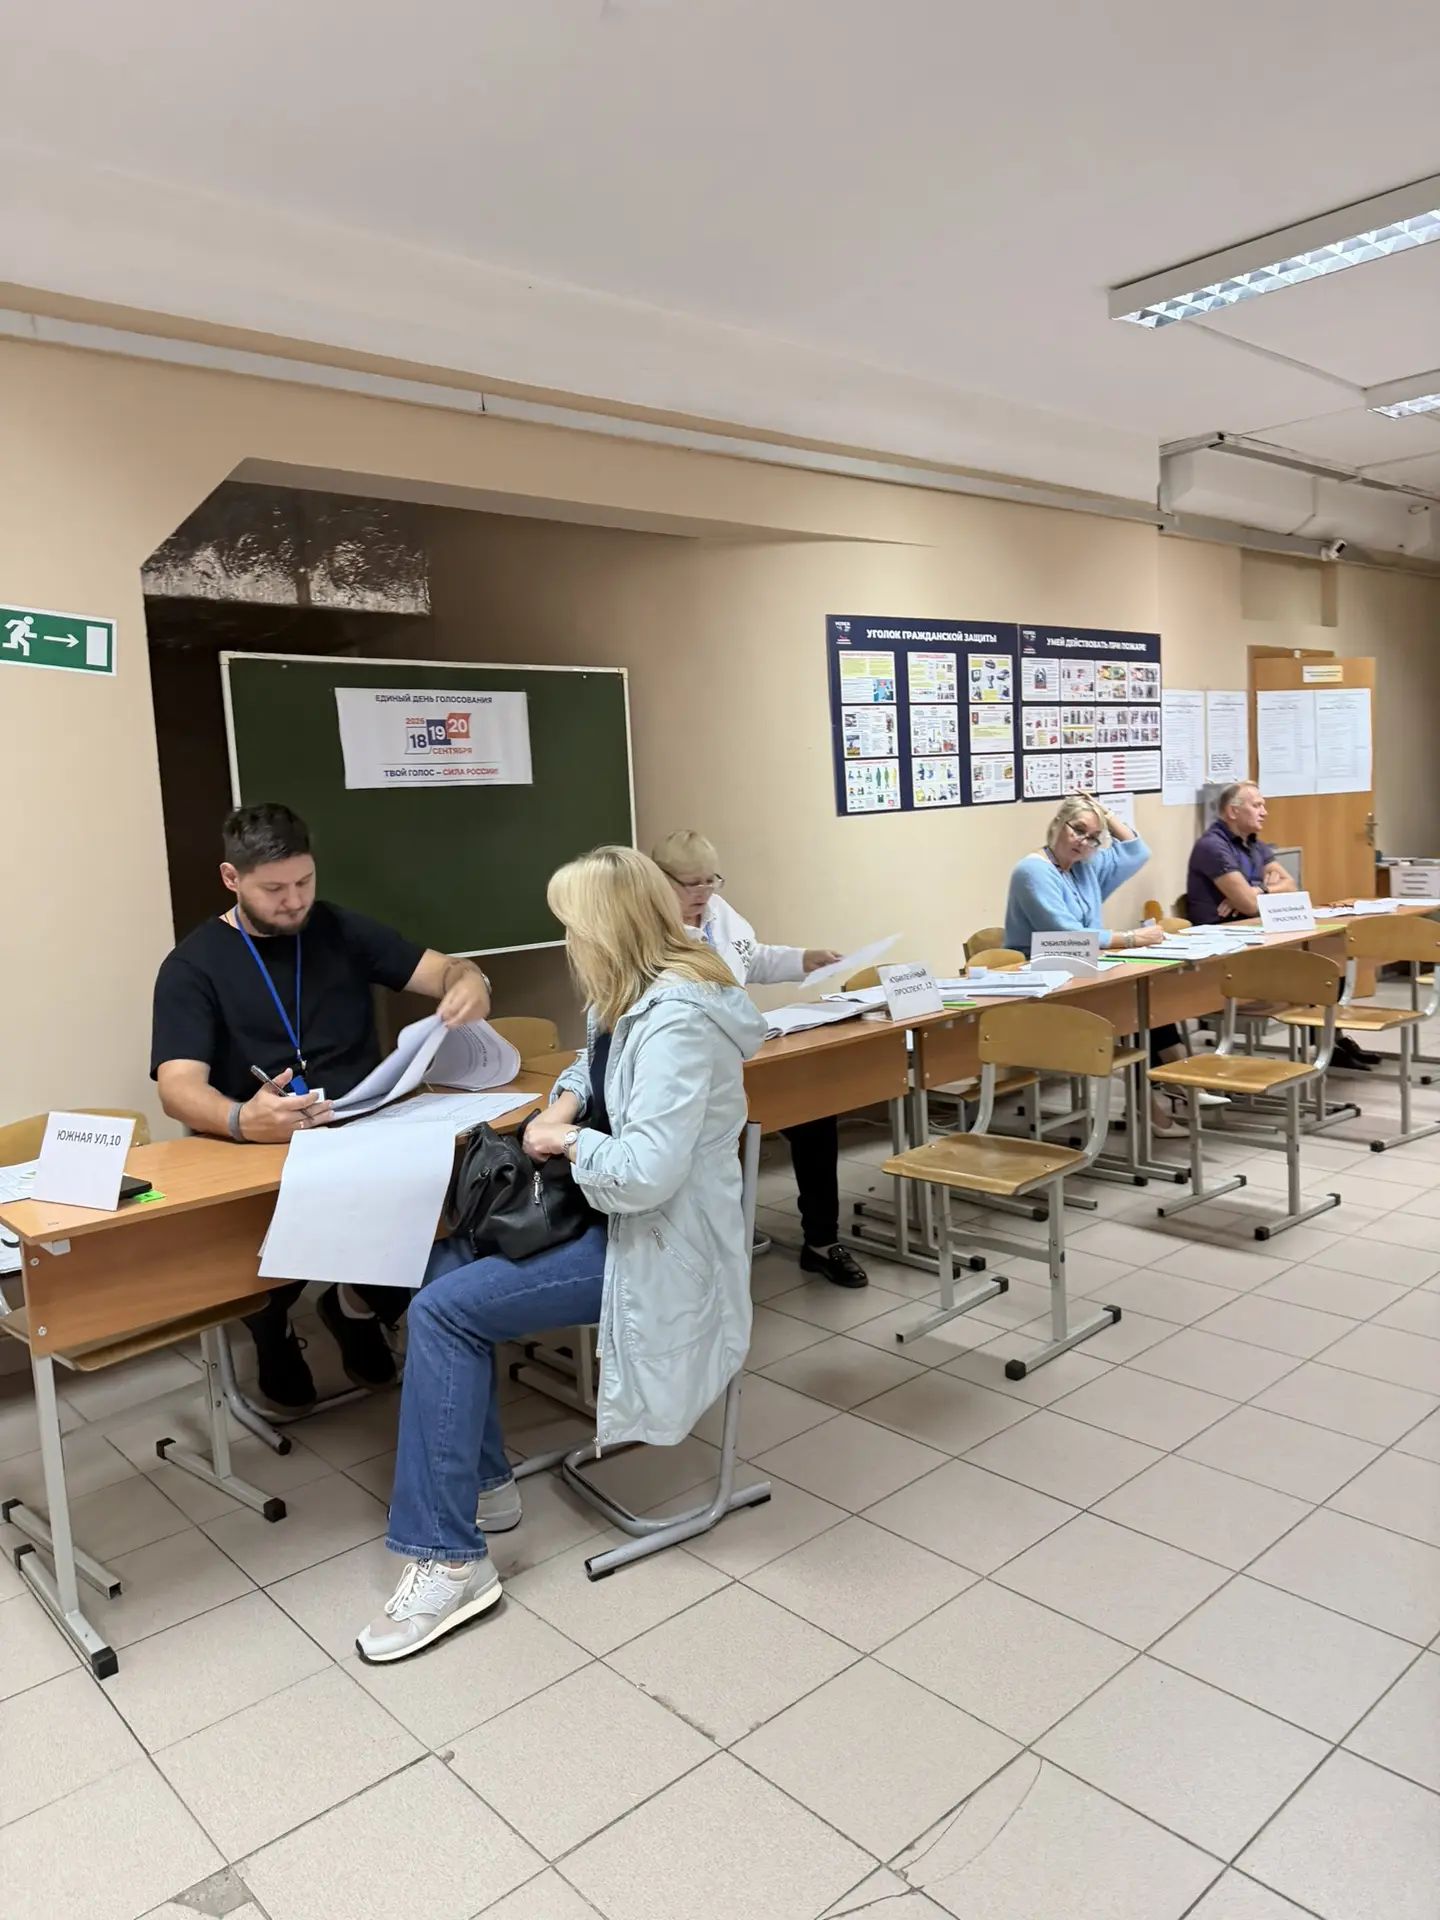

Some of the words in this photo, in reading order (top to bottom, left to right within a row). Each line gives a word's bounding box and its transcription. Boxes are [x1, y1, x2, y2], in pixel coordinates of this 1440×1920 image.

[866, 628, 902, 640] УГОЛОК
[902, 630, 963, 642] ГРАЖДАНСКОЙ
[964, 632, 998, 644] ЗАЩИТЫ
[1046, 636, 1065, 646] УМЕЙ
[375, 693, 411, 703] ЕДИНЫЙ
[412, 695, 435, 703] ДЕНЬ
[435, 695, 493, 704] ГОЛОСОВАНИЯ
[409, 733, 427, 749] 18
[428, 725, 446, 741] 19
[447, 718, 468, 733] 20
[432, 747, 473, 755] СЕНТЯБРЯ
[384, 767, 407, 777] ТВОЙ
[408, 768, 435, 777] ГОЛОС
[443, 768, 465, 776] СИЛА
[1040, 938, 1091, 947] ЮБИЛЕЙНЫЙ
[889, 968, 927, 984] ЮБИЛЕЙНЫЙ
[894, 983, 926, 997] ПРОСПЕКТ,
[925, 981, 933, 990] 12
[56, 1129, 93, 1143] ЮЖНАЯ
[94, 1132, 122, 1147] УЛ,10
[420, 1583, 457, 1610] N
